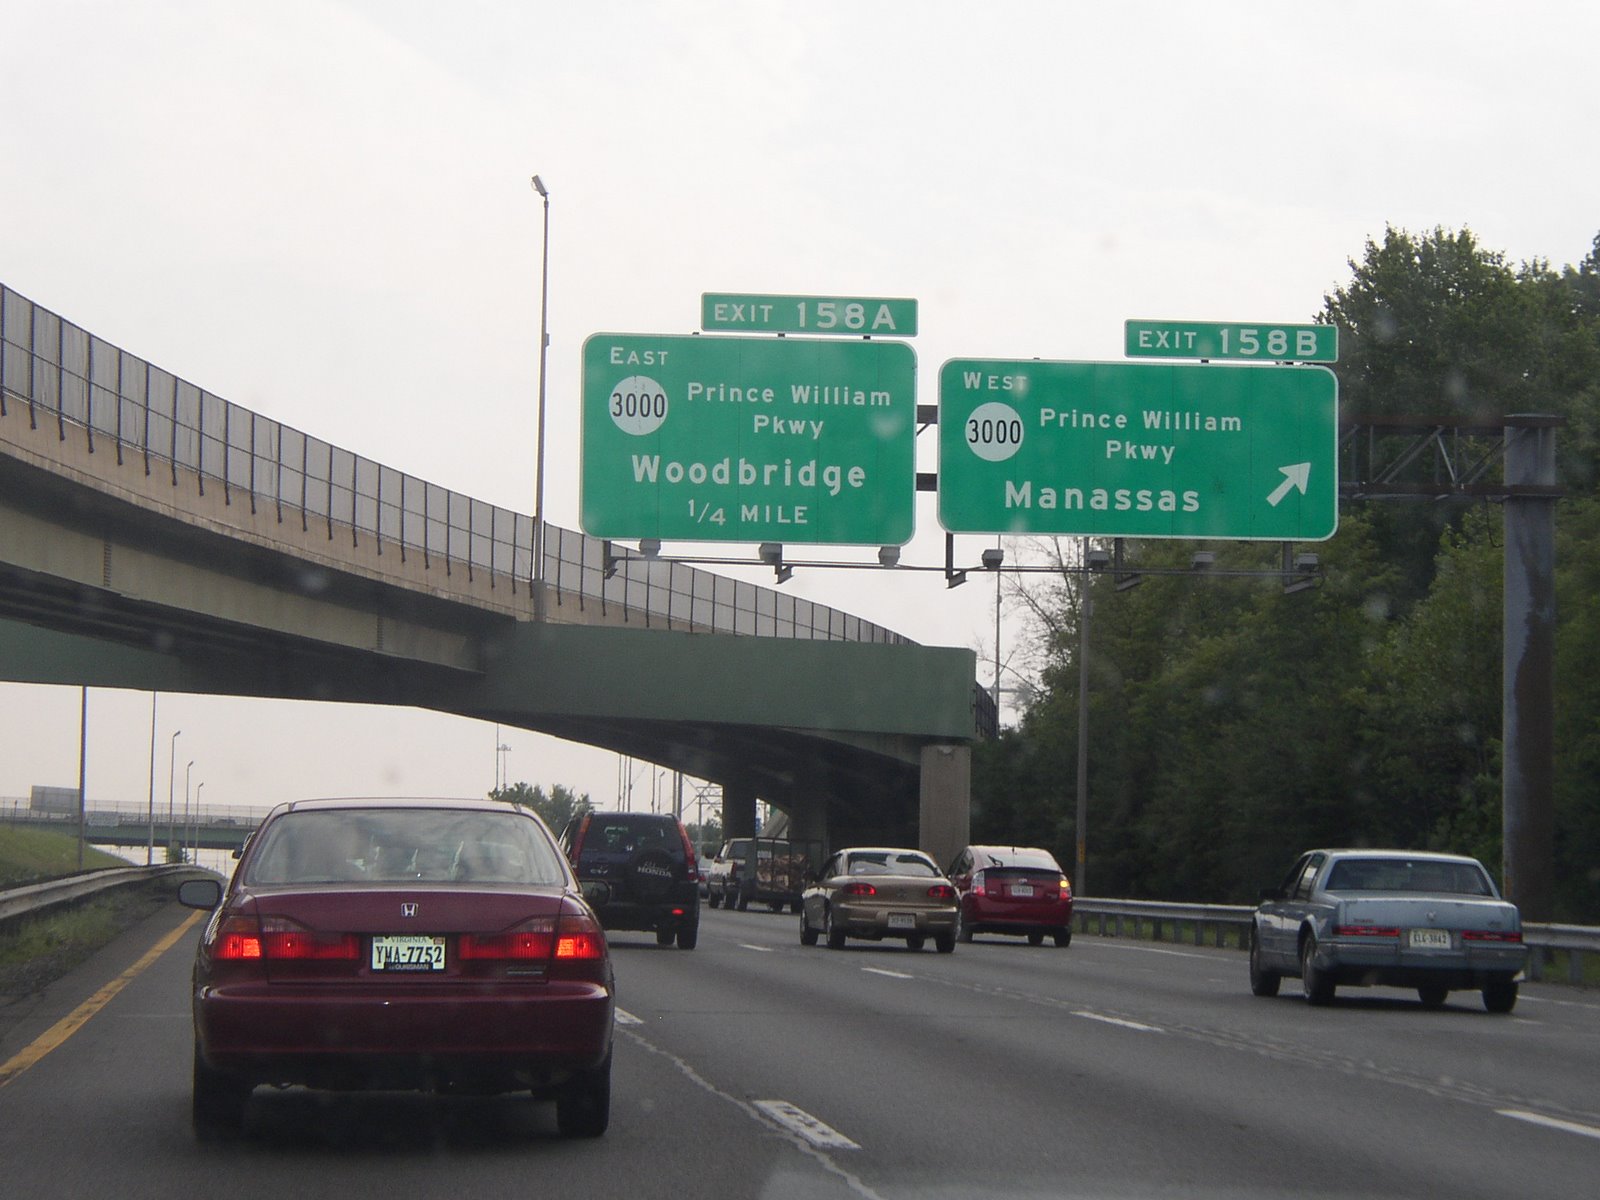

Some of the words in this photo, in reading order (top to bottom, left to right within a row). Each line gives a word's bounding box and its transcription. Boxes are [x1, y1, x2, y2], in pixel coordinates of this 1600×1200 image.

[714, 304, 773, 323] EXIT
[797, 302, 896, 330] 158A
[1139, 330, 1197, 349] EXIT
[1219, 328, 1318, 356] 158B
[610, 347, 668, 366] EAST
[963, 372, 1027, 391] WEST
[611, 393, 666, 418] 3000
[687, 382, 775, 403] Prince
[791, 385, 891, 406] William
[753, 415, 824, 440] Pkwy
[968, 418, 1021, 444] 3000
[1040, 408, 1128, 429] Prince
[1143, 410, 1242, 432] William
[1106, 440, 1176, 464] Pkwy
[631, 454, 866, 497] Woodbridge
[1004, 480, 1200, 513] Manassas
[741, 504, 808, 524] MILE
[390, 936, 428, 944] VIRGINIA
